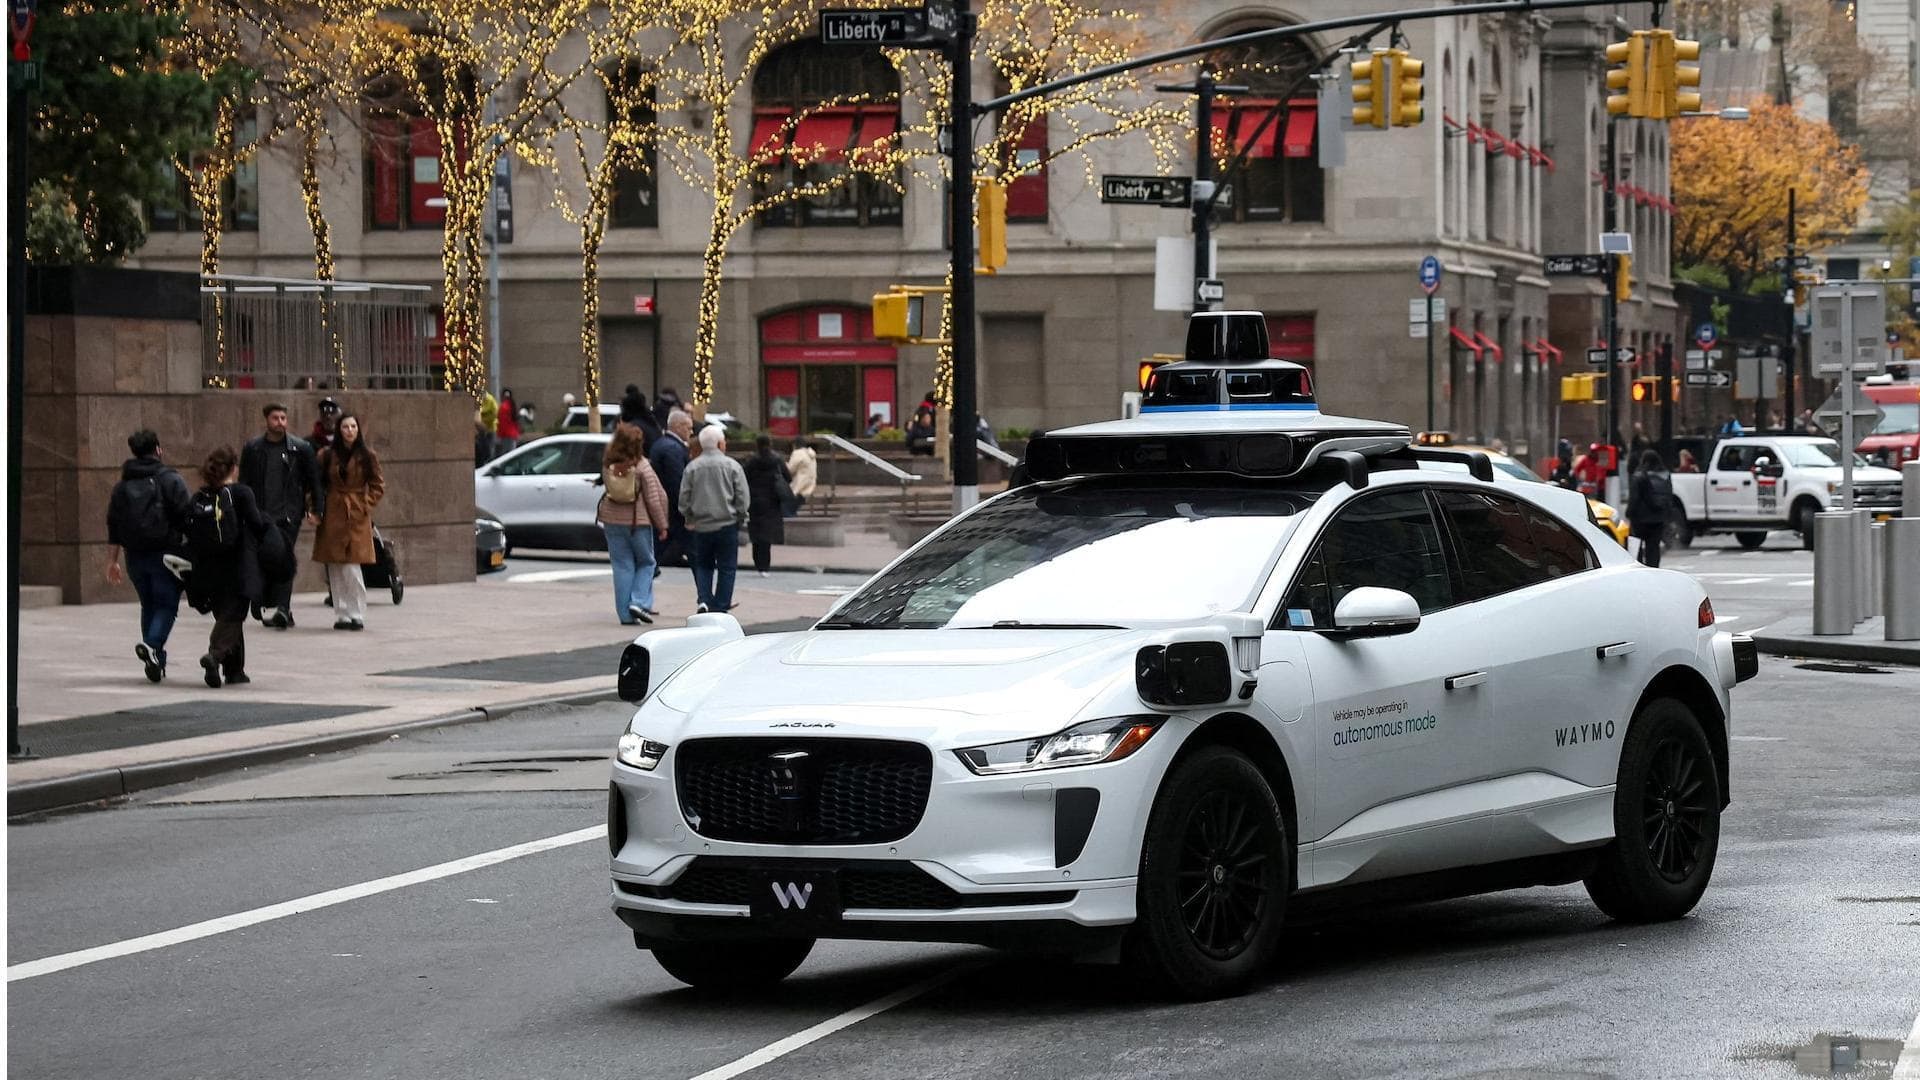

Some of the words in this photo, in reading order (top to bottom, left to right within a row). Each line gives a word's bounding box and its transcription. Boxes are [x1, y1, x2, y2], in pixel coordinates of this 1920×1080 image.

[829, 20, 887, 41] Liberty
[1108, 182, 1151, 201] Liberty
[1332, 708, 1353, 722] Vehicle
[1353, 710, 1367, 720] may
[1367, 705, 1375, 716] be
[1375, 701, 1402, 717] operating
[1402, 699, 1409, 710] in
[1333, 720, 1403, 746] autonomous
[1405, 709, 1436, 734] mode
[1555, 720, 1615, 748] WAYMO
